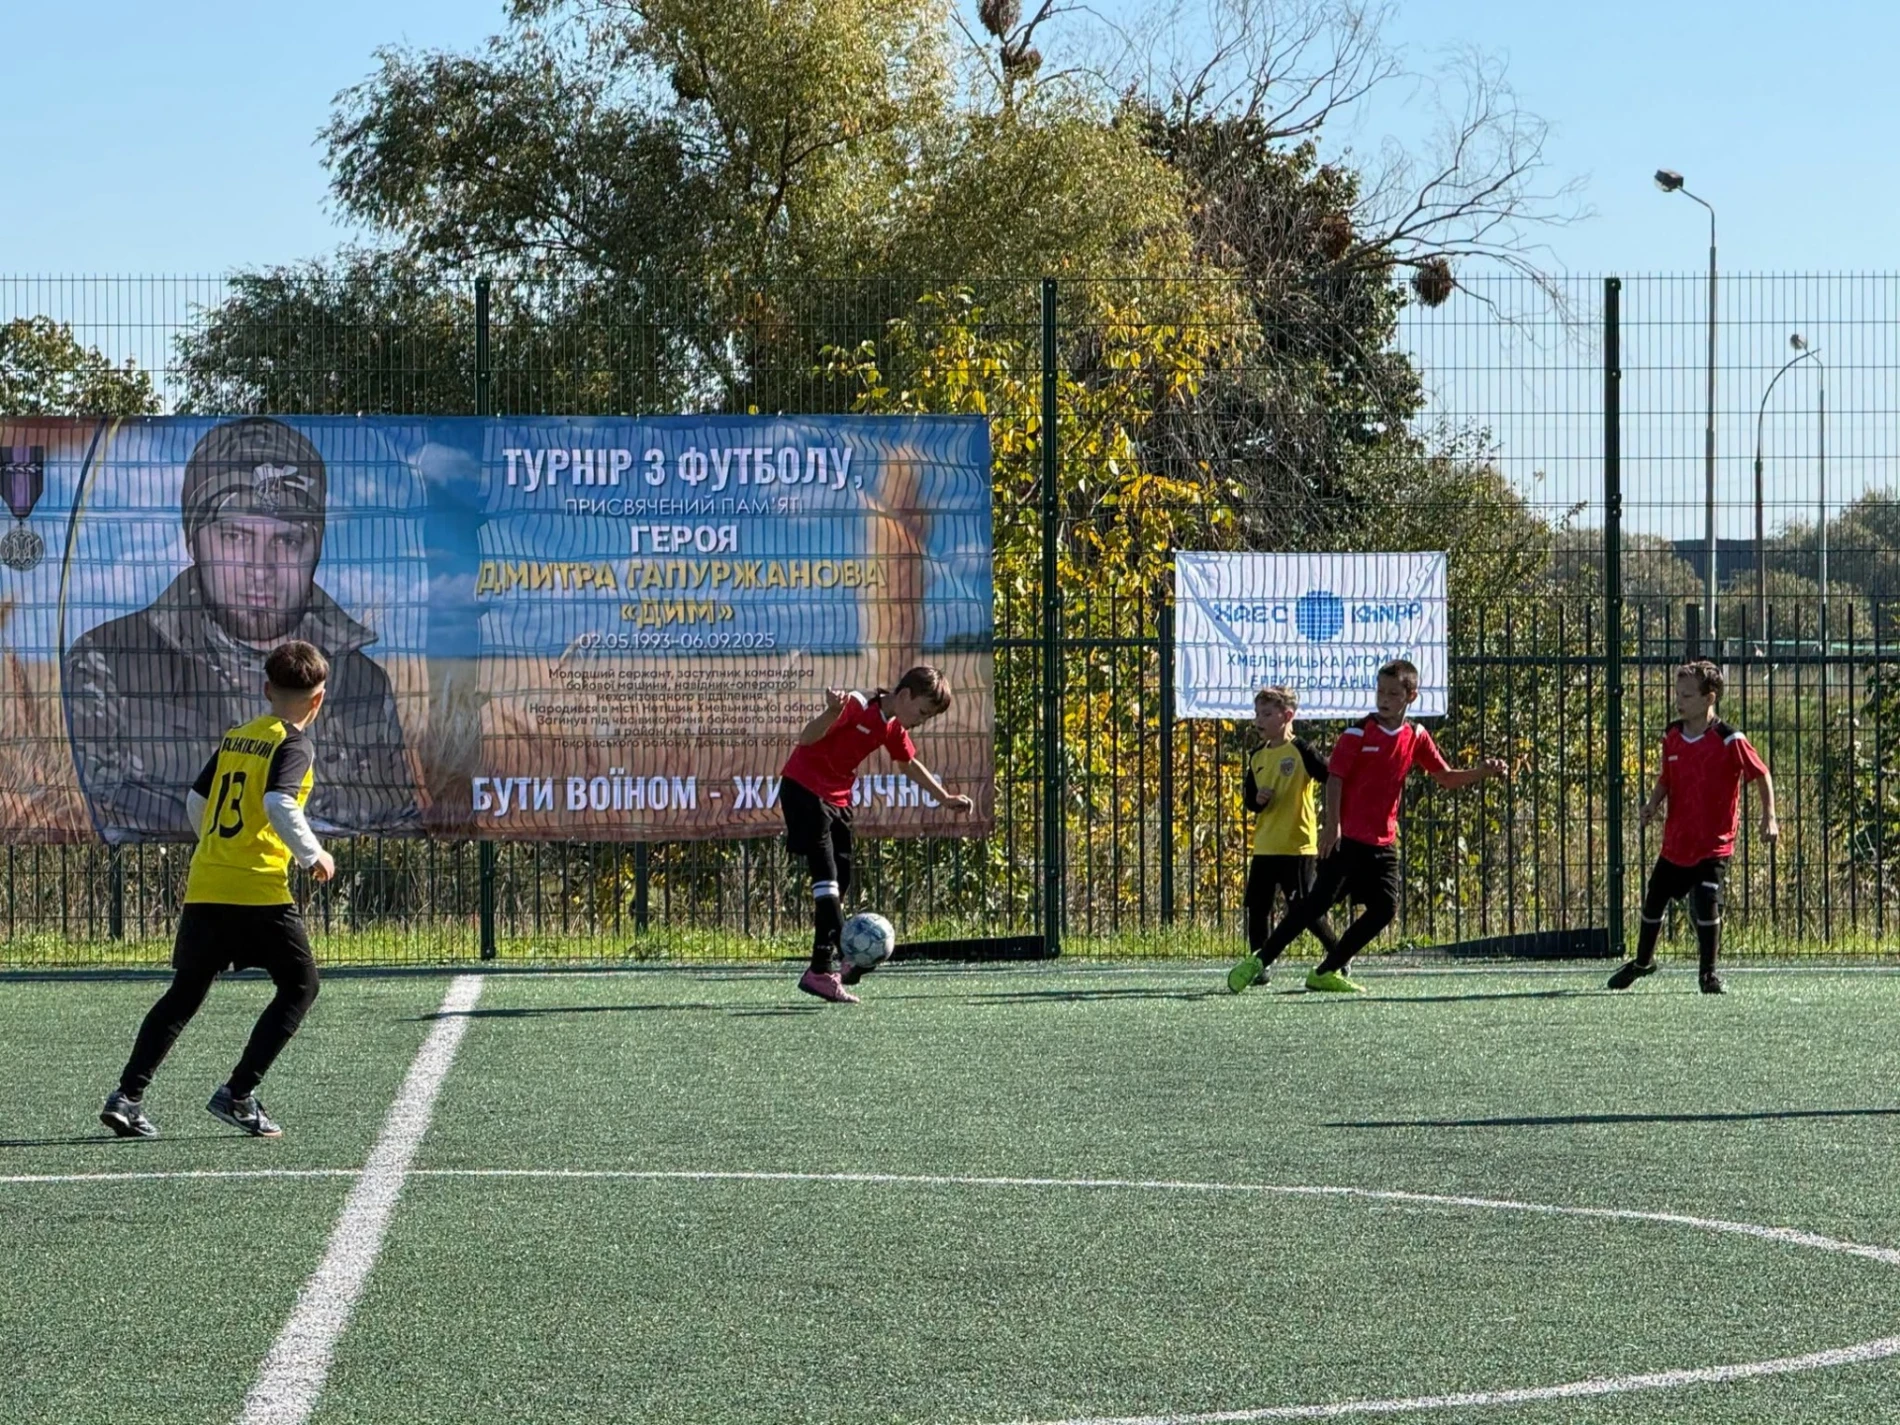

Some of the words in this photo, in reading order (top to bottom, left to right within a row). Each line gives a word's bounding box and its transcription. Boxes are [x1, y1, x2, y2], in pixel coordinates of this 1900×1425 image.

[502, 447, 631, 492] ТУРНІР
[679, 444, 863, 492] ФУТБОЛУ,
[565, 496, 716, 517] ПРИСВЯЧЕНИЙ
[631, 525, 738, 553] ГЕРОЯ
[477, 561, 617, 595] ДМИТРА
[627, 559, 887, 590] ГАПУРЖАНОВА
[1227, 653, 1340, 669] ХМЕЛЬНИЦЬКА
[1345, 652, 1413, 668] АТОМ
[549, 668, 616, 681] Молодший
[618, 670, 674, 681] сержант,
[677, 669, 741, 680] заступник
[744, 669, 814, 680] командира
[1251, 674, 1385, 689] ЕЛЕКТРОСТАНЦІ
[566, 680, 615, 691] бойової
[618, 682, 671, 691] машини,
[675, 680, 797, 691] навідник-оператор
[530, 704, 598, 715] Народився
[784, 702, 827, 712] област
[537, 715, 587, 726] Загинув
[761, 737, 798, 747] облас
[473, 777, 553, 816] БУТИ
[566, 767, 697, 811] ВОЇНОМ
[208, 771, 247, 838] 13
